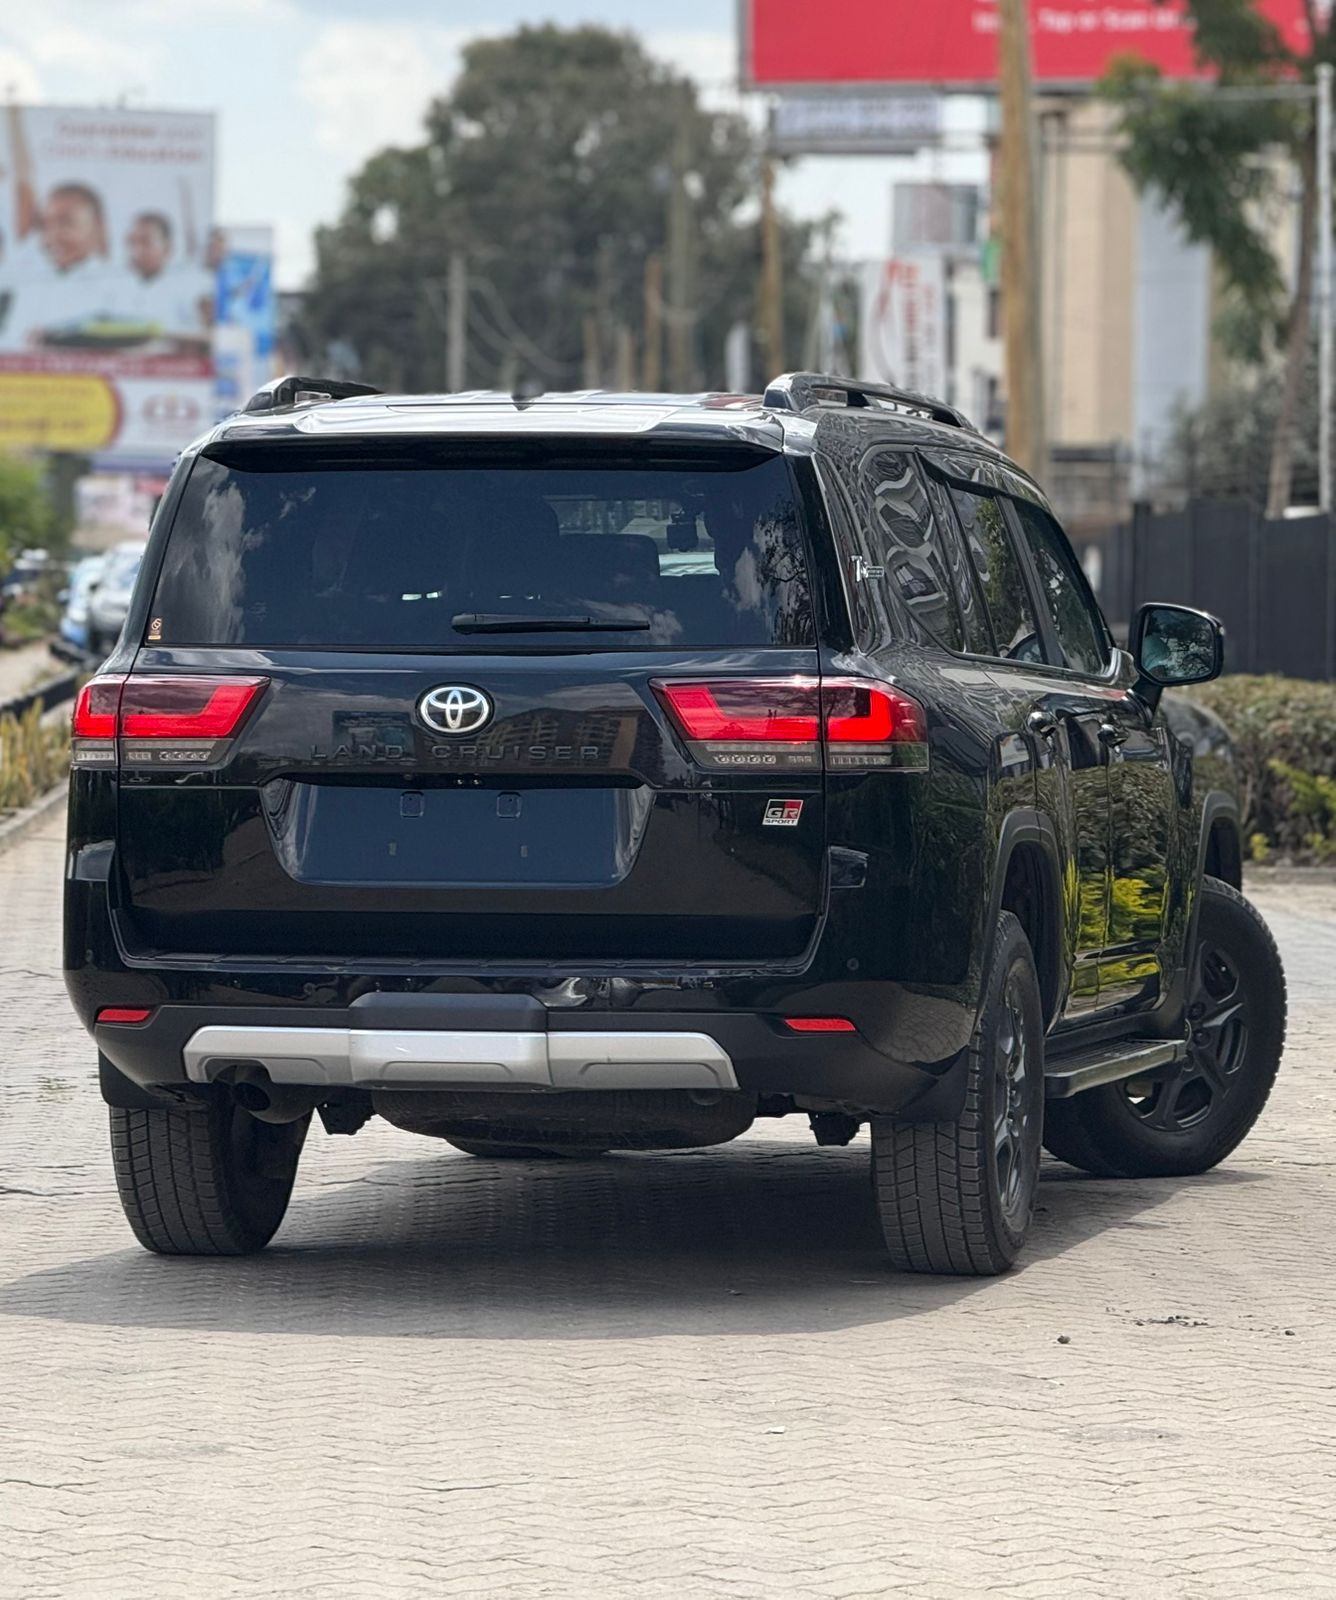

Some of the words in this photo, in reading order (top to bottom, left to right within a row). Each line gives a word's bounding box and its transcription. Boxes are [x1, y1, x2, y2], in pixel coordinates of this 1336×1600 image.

[311, 744, 404, 760] LAND
[431, 745, 600, 760] CRUISER
[767, 807, 799, 818] GR
